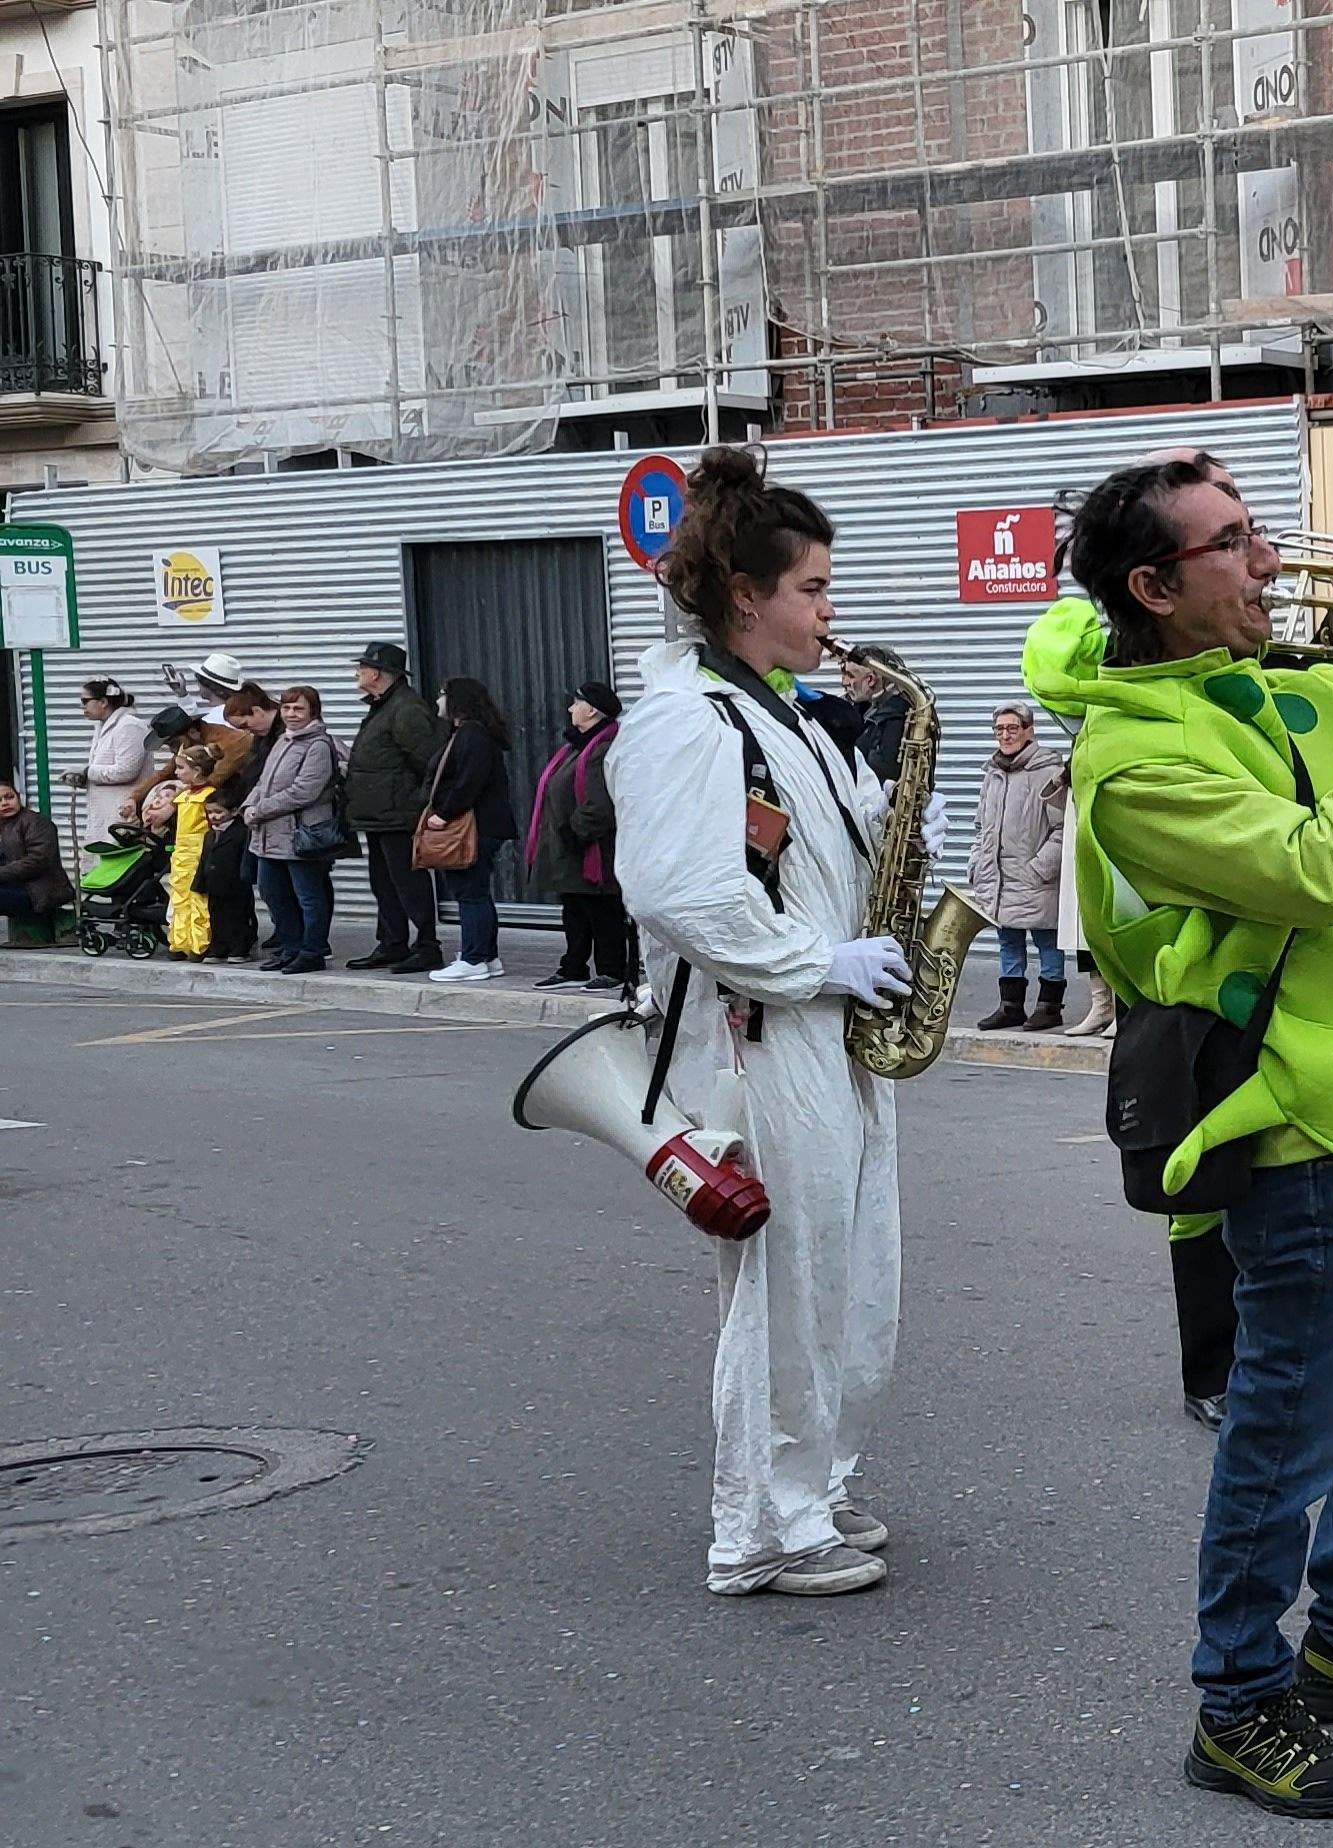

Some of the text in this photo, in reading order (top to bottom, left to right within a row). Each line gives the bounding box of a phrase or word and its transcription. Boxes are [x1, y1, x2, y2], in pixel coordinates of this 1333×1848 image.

[651, 500, 662, 519] P
[648, 520, 666, 530] Bus
[0, 538, 50, 547] avanza
[14, 560, 53, 575] BUS
[967, 556, 1047, 581] Añaños
[985, 581, 1047, 594] Constructora
